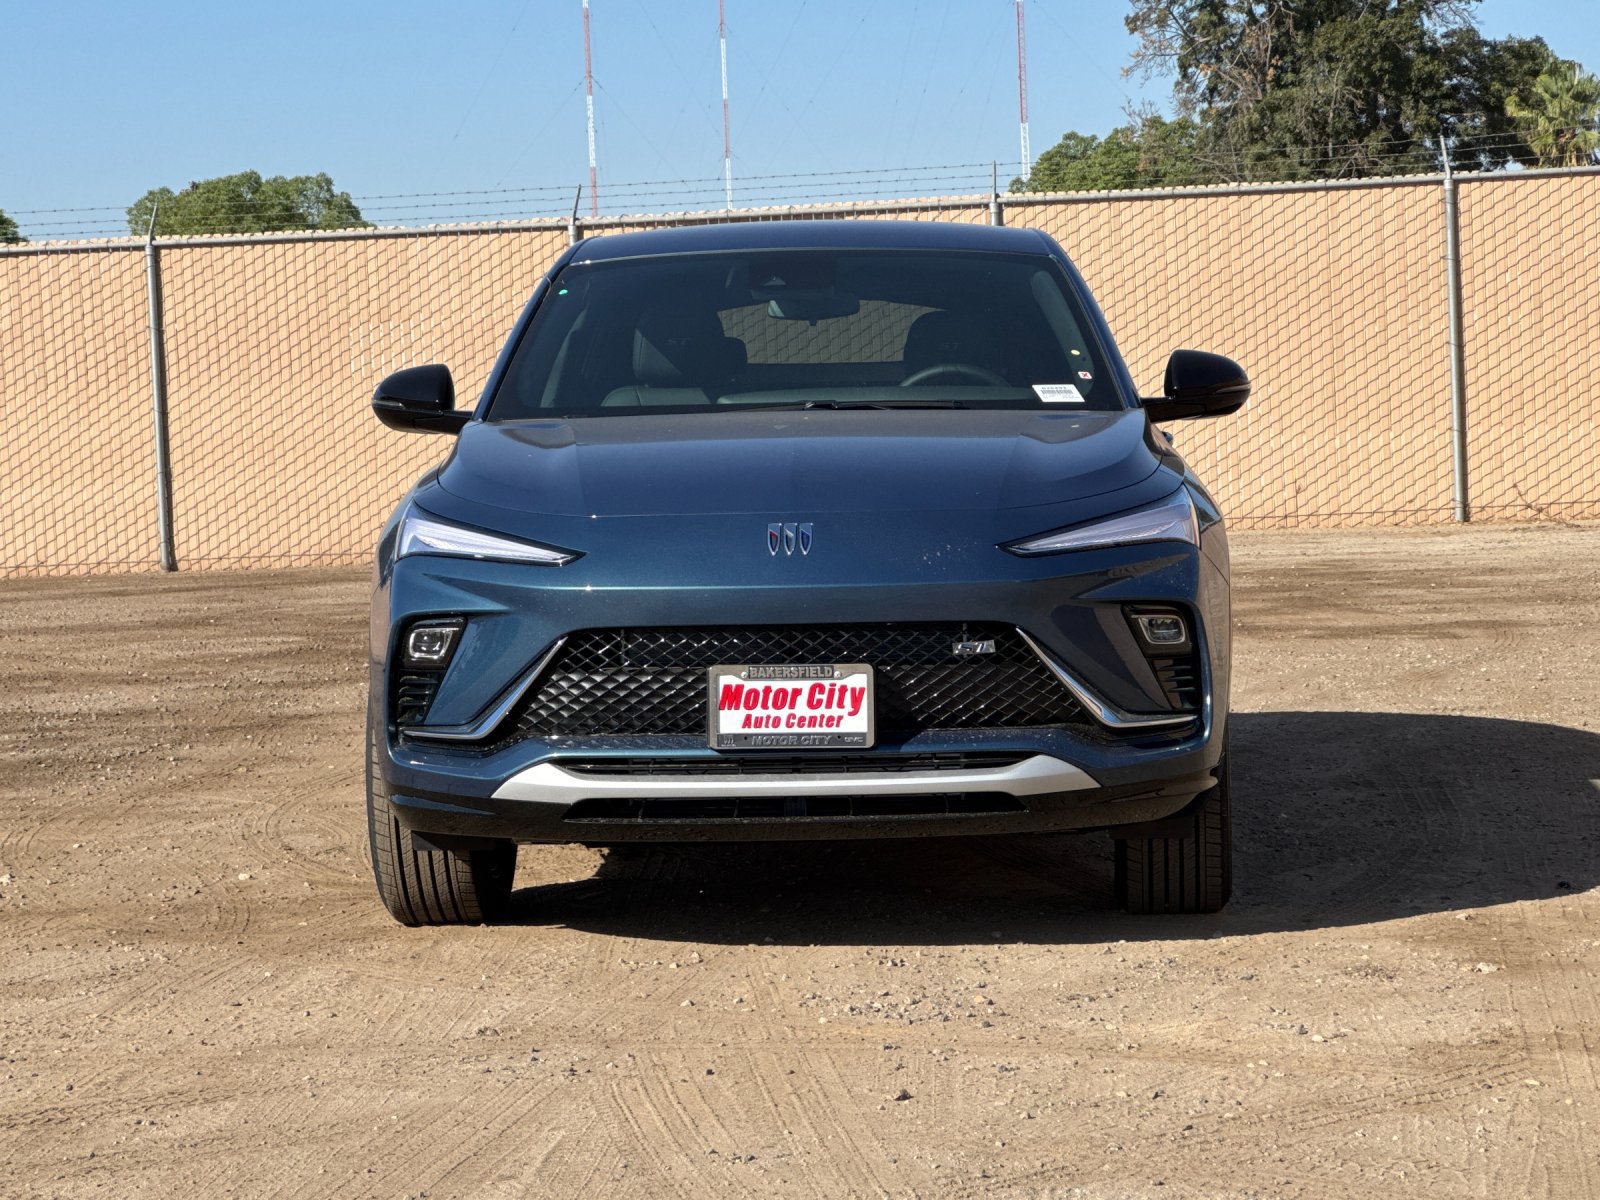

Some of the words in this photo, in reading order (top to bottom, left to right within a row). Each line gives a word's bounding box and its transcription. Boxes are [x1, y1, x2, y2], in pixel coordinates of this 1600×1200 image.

[749, 666, 833, 678] BAKERSFIELD
[719, 683, 803, 711] Motor
[806, 682, 866, 716] City
[741, 713, 782, 729] Auto
[785, 712, 844, 729] Center
[751, 735, 798, 746] MOTOR
[800, 735, 832, 745] CITY
